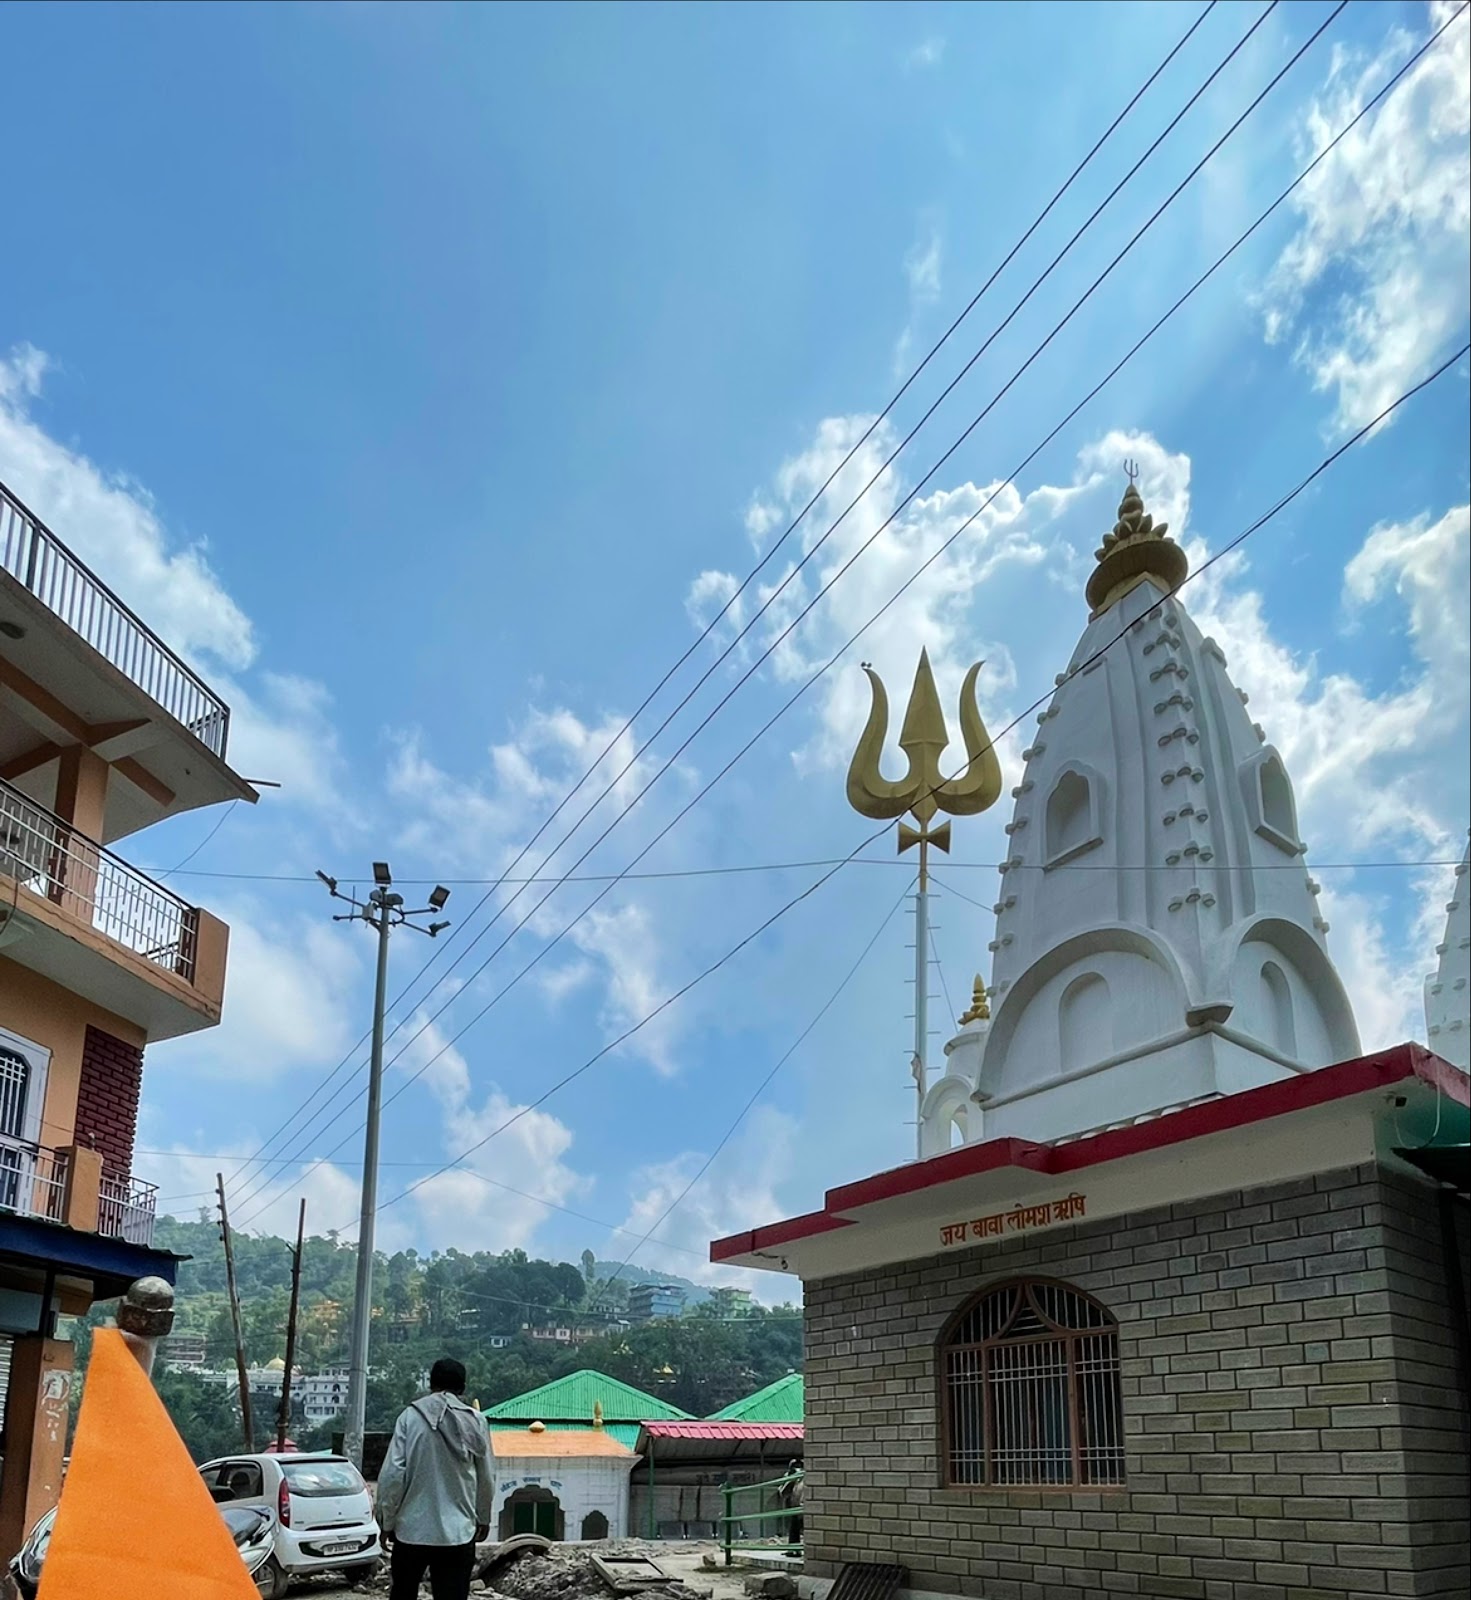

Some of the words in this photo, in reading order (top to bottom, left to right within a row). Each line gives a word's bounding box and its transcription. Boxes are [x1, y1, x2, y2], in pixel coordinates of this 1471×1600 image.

[940, 1222, 968, 1246] जय
[970, 1213, 1004, 1238] बाबा
[1005, 1203, 1051, 1231] लोमश
[1052, 1192, 1086, 1220] ऋषि
